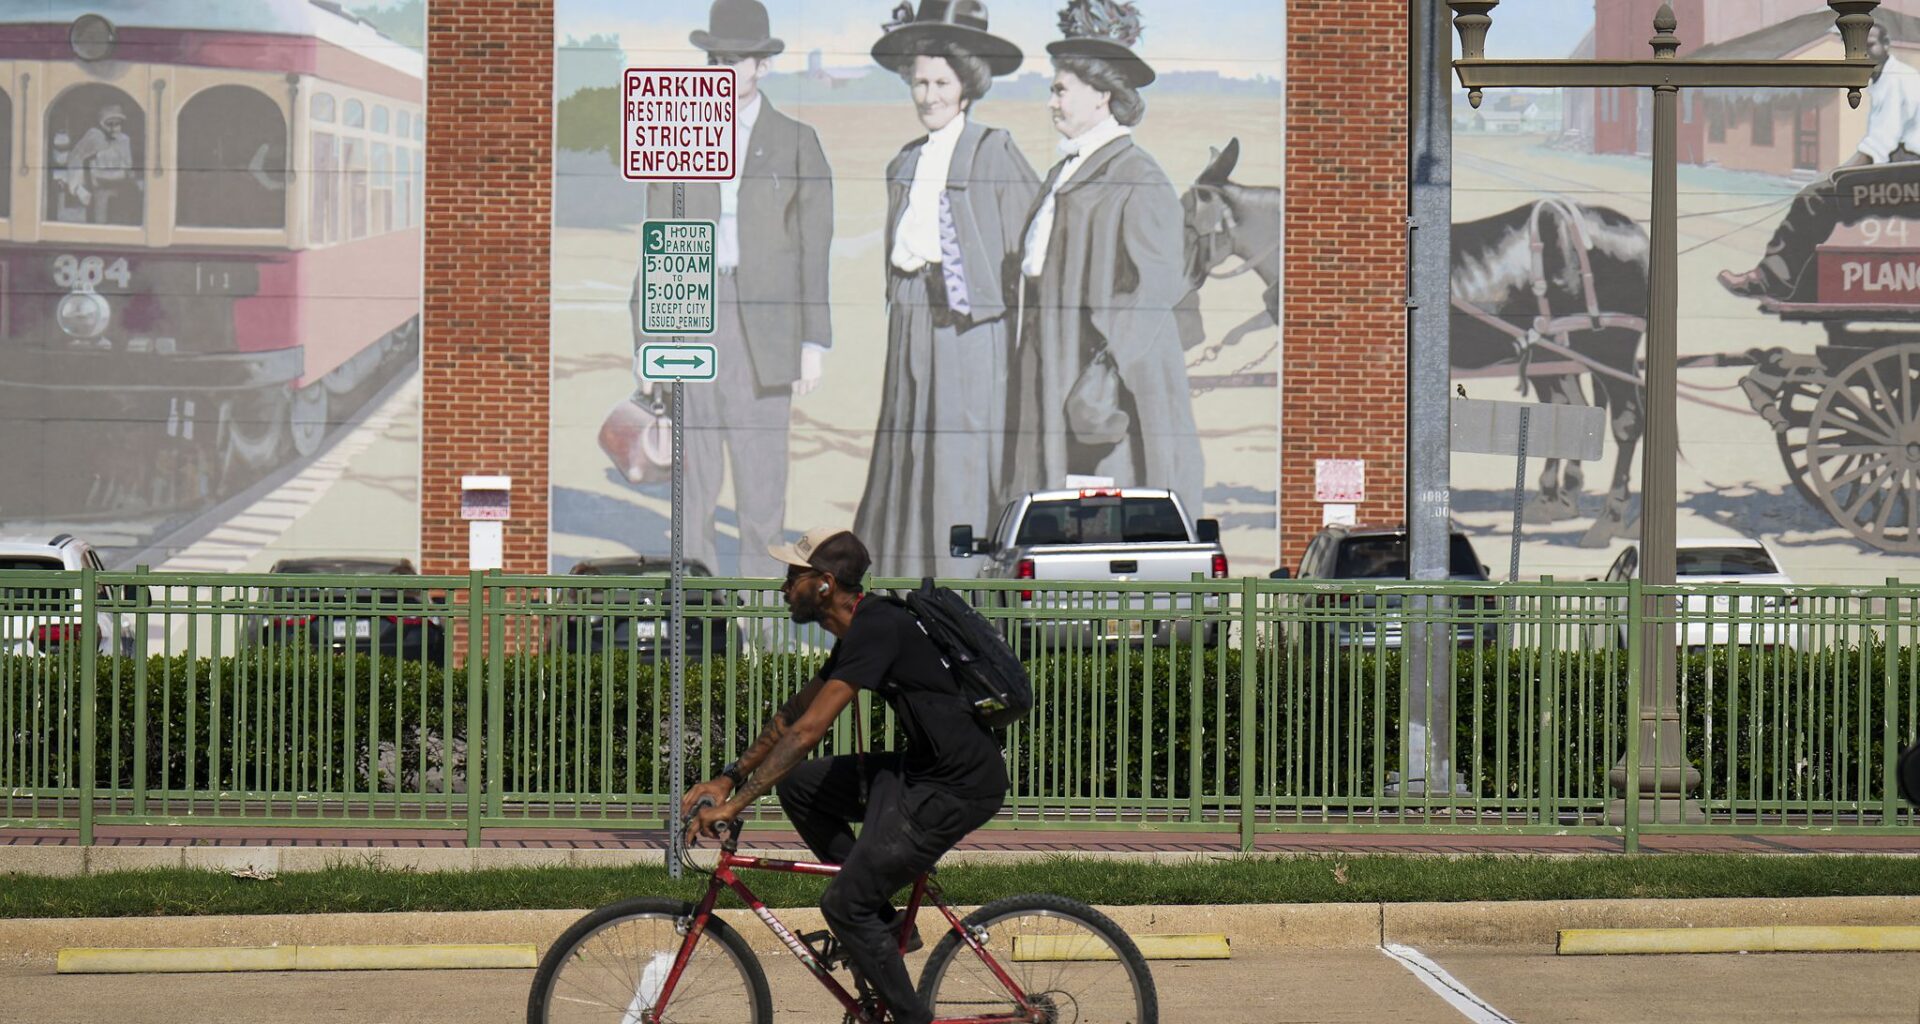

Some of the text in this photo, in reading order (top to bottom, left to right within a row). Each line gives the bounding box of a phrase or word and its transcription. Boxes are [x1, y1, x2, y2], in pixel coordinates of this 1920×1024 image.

[629, 76, 731, 97] PARKING
[628, 101, 731, 122] RESTRICTIONS
[635, 126, 724, 147] STRICTLY
[630, 151, 729, 172] ENFORCED
[649, 229, 664, 250] 3
[671, 227, 706, 238] HOUR
[1860, 214, 1909, 246] 94
[666, 240, 711, 252] PARKING
[647, 256, 710, 273] 5:00AM
[647, 283, 709, 300] 5:00PM
[651, 303, 706, 314] EXCEPT CITY
[649, 316, 710, 328] ISSUED PERMITS
